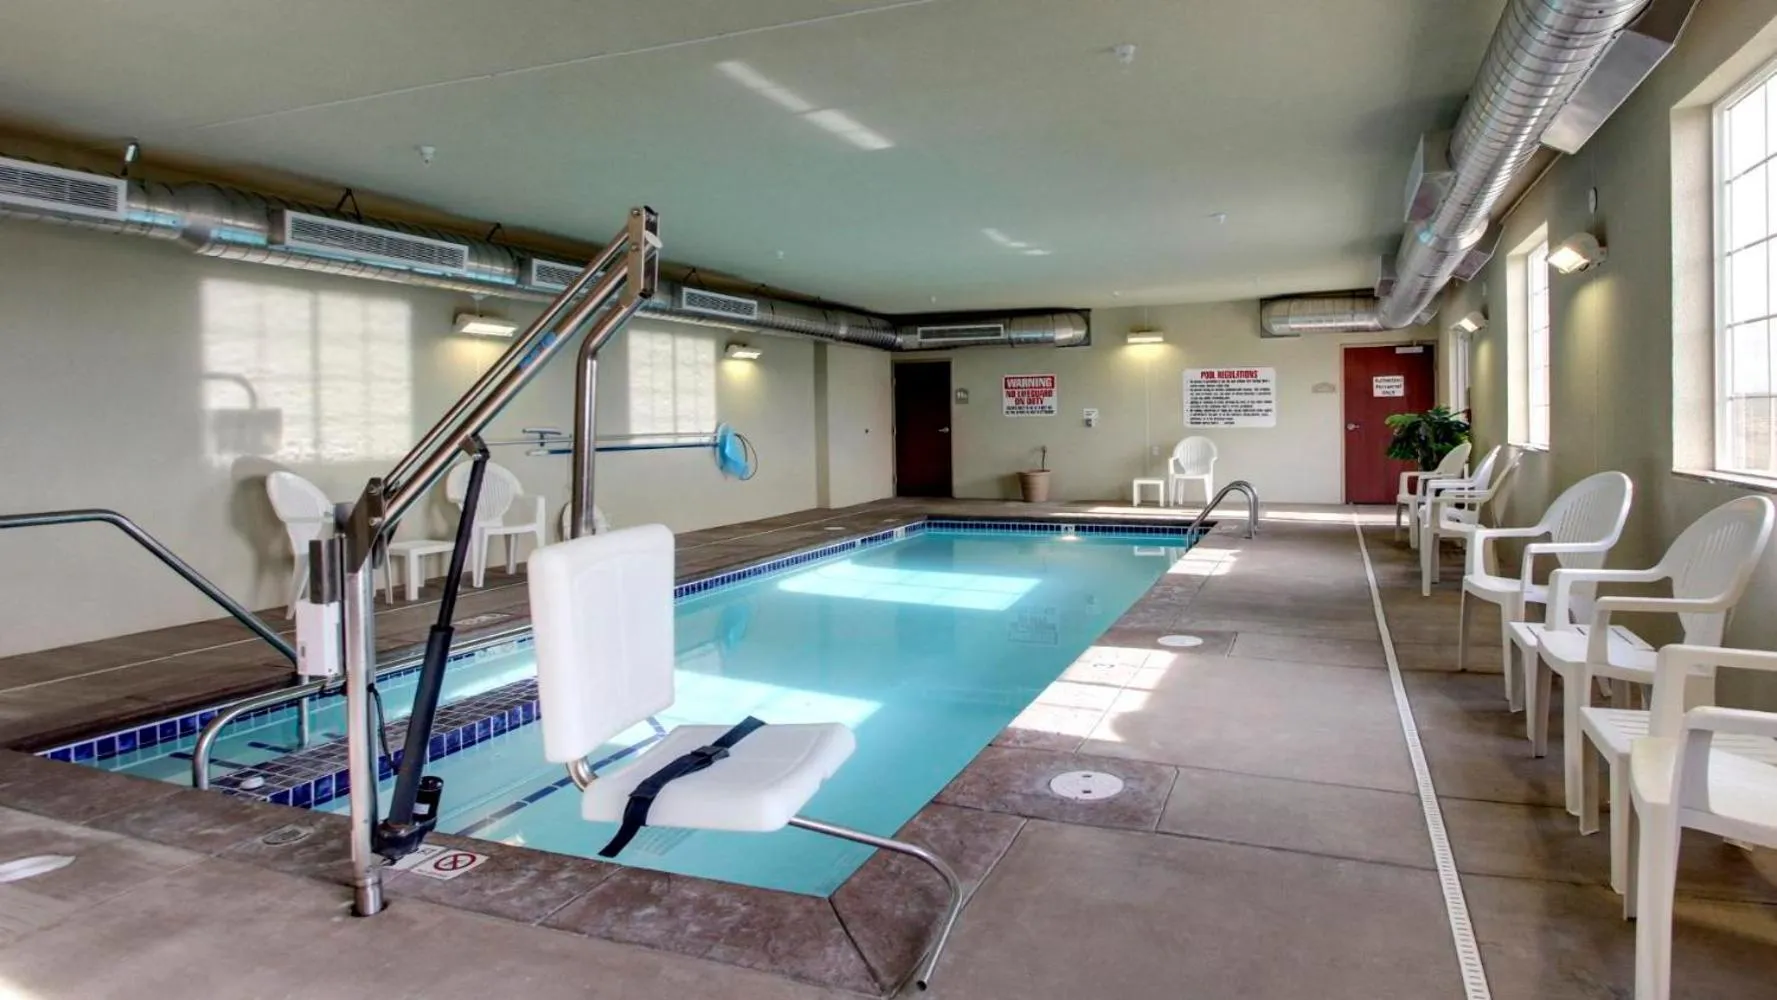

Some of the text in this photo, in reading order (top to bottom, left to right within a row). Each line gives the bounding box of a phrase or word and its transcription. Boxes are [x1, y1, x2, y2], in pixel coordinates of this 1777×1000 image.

[1200, 370, 1258, 379] POOL REGULATIONS
[1006, 378, 1053, 388] WARNING
[1018, 389, 1053, 397] LIFEGUARD
[1015, 397, 1043, 405] ON DUTY
